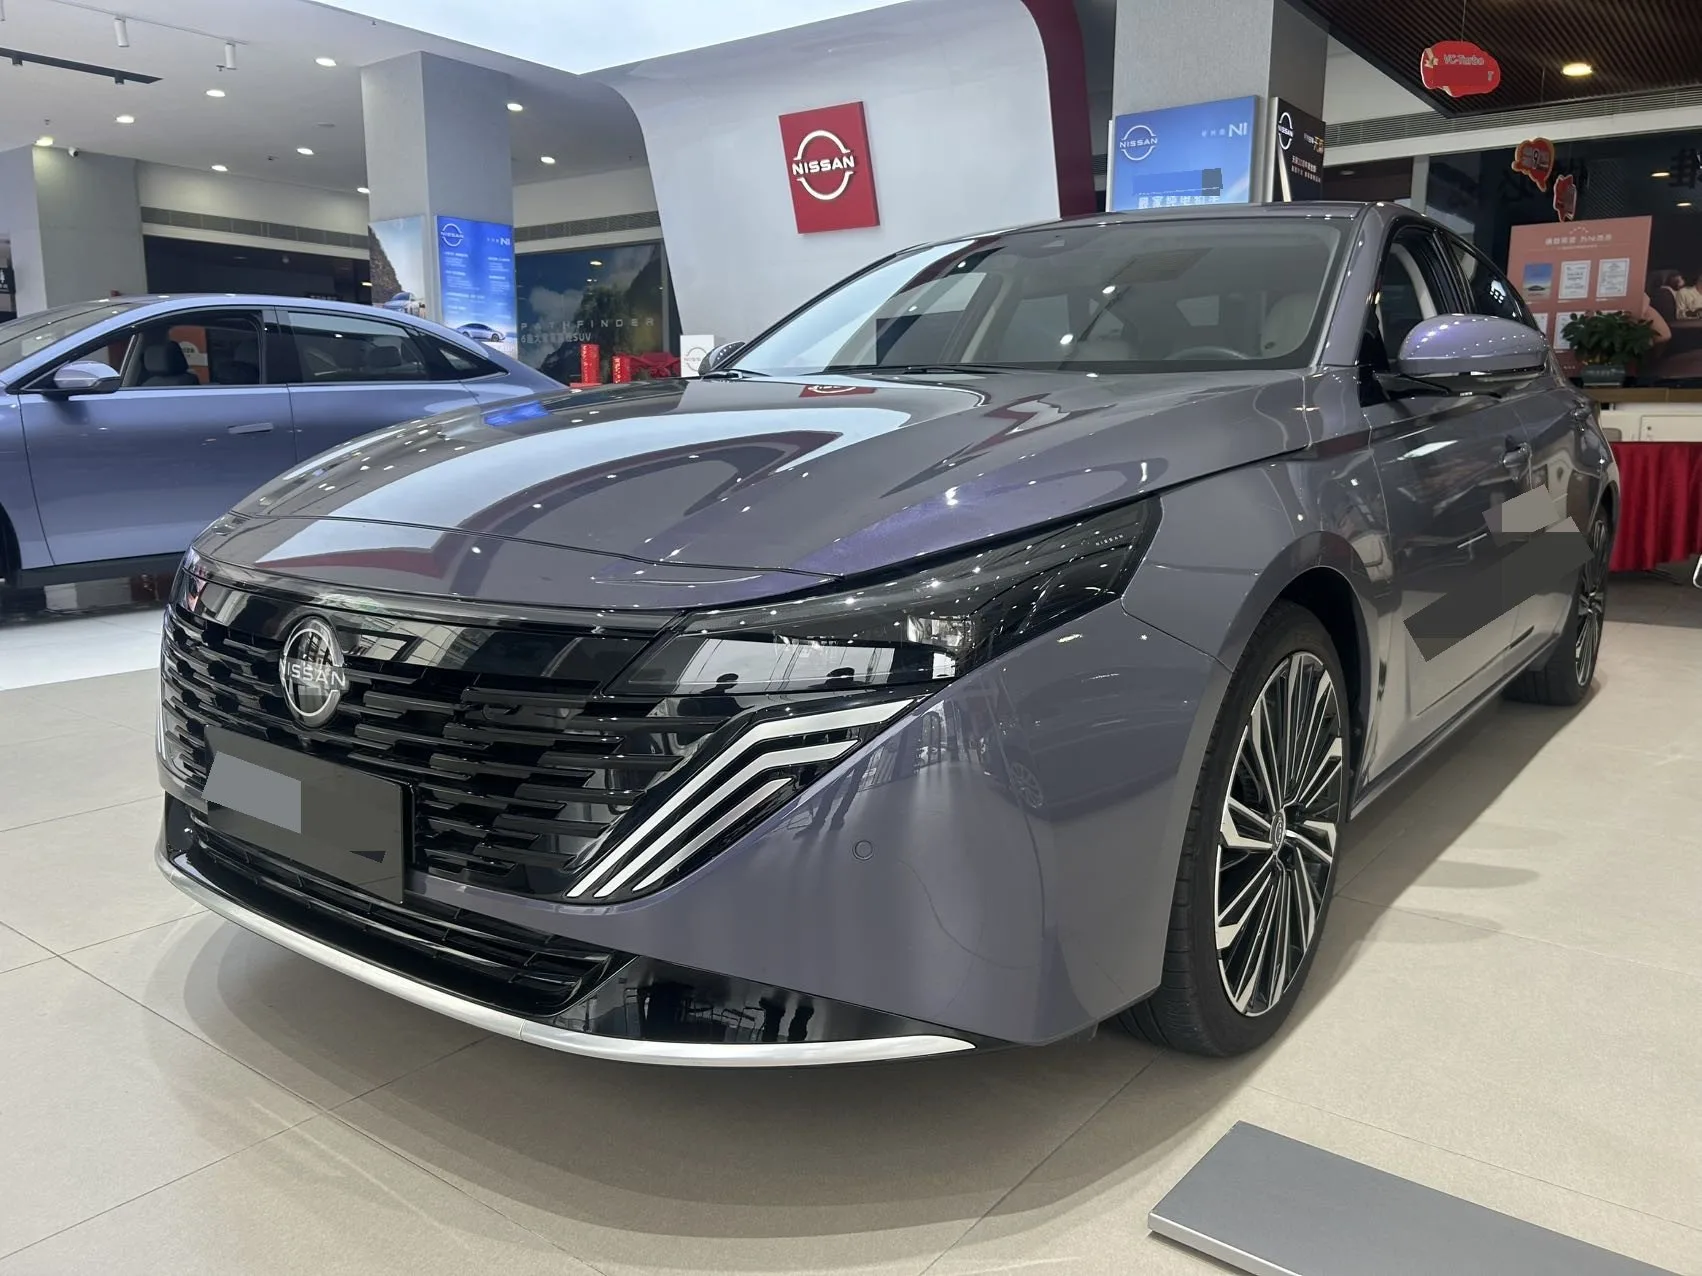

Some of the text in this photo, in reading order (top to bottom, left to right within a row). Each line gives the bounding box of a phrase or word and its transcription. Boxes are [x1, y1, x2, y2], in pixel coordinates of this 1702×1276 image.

[1443, 54, 1484, 66] VC-Turbo
[1278, 125, 1294, 138] NISSAN
[1120, 138, 1158, 148] NISSAN
[792, 155, 855, 175] NISSAN
[440, 231, 464, 239] NISSAN
[521, 318, 654, 330] PATHFINDER
[279, 657, 346, 687] NISSAN
